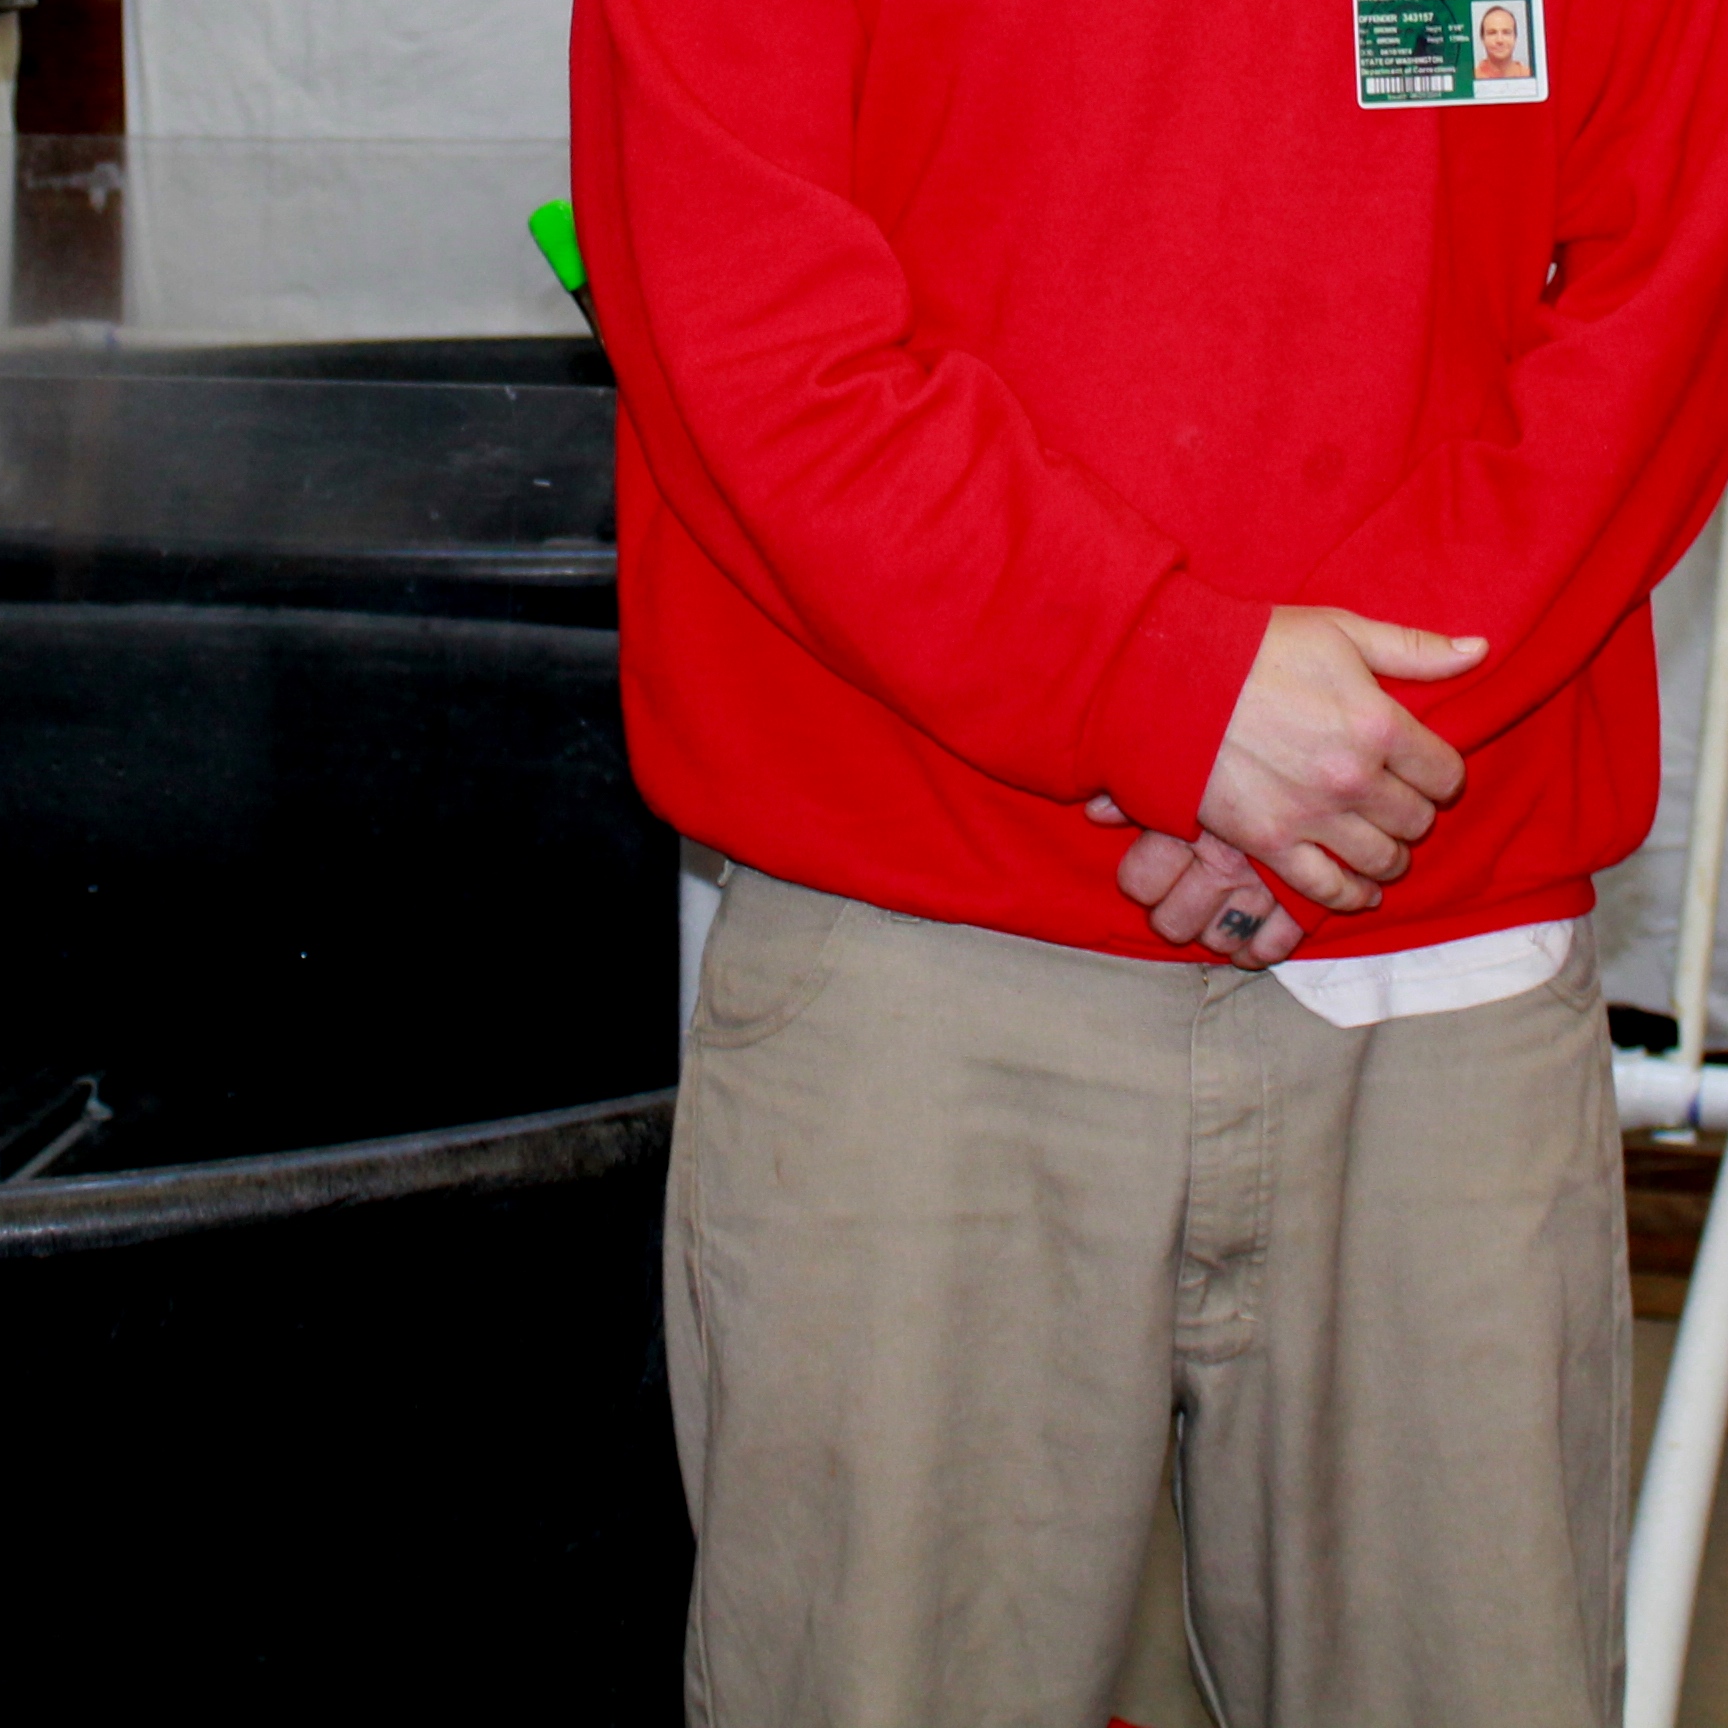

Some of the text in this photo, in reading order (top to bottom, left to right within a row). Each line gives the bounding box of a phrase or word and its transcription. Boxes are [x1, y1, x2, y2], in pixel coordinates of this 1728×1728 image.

[1358, 13, 1398, 23] OFFENDER
[1360, 55, 1444, 66] STATE OF WASHINGTON
